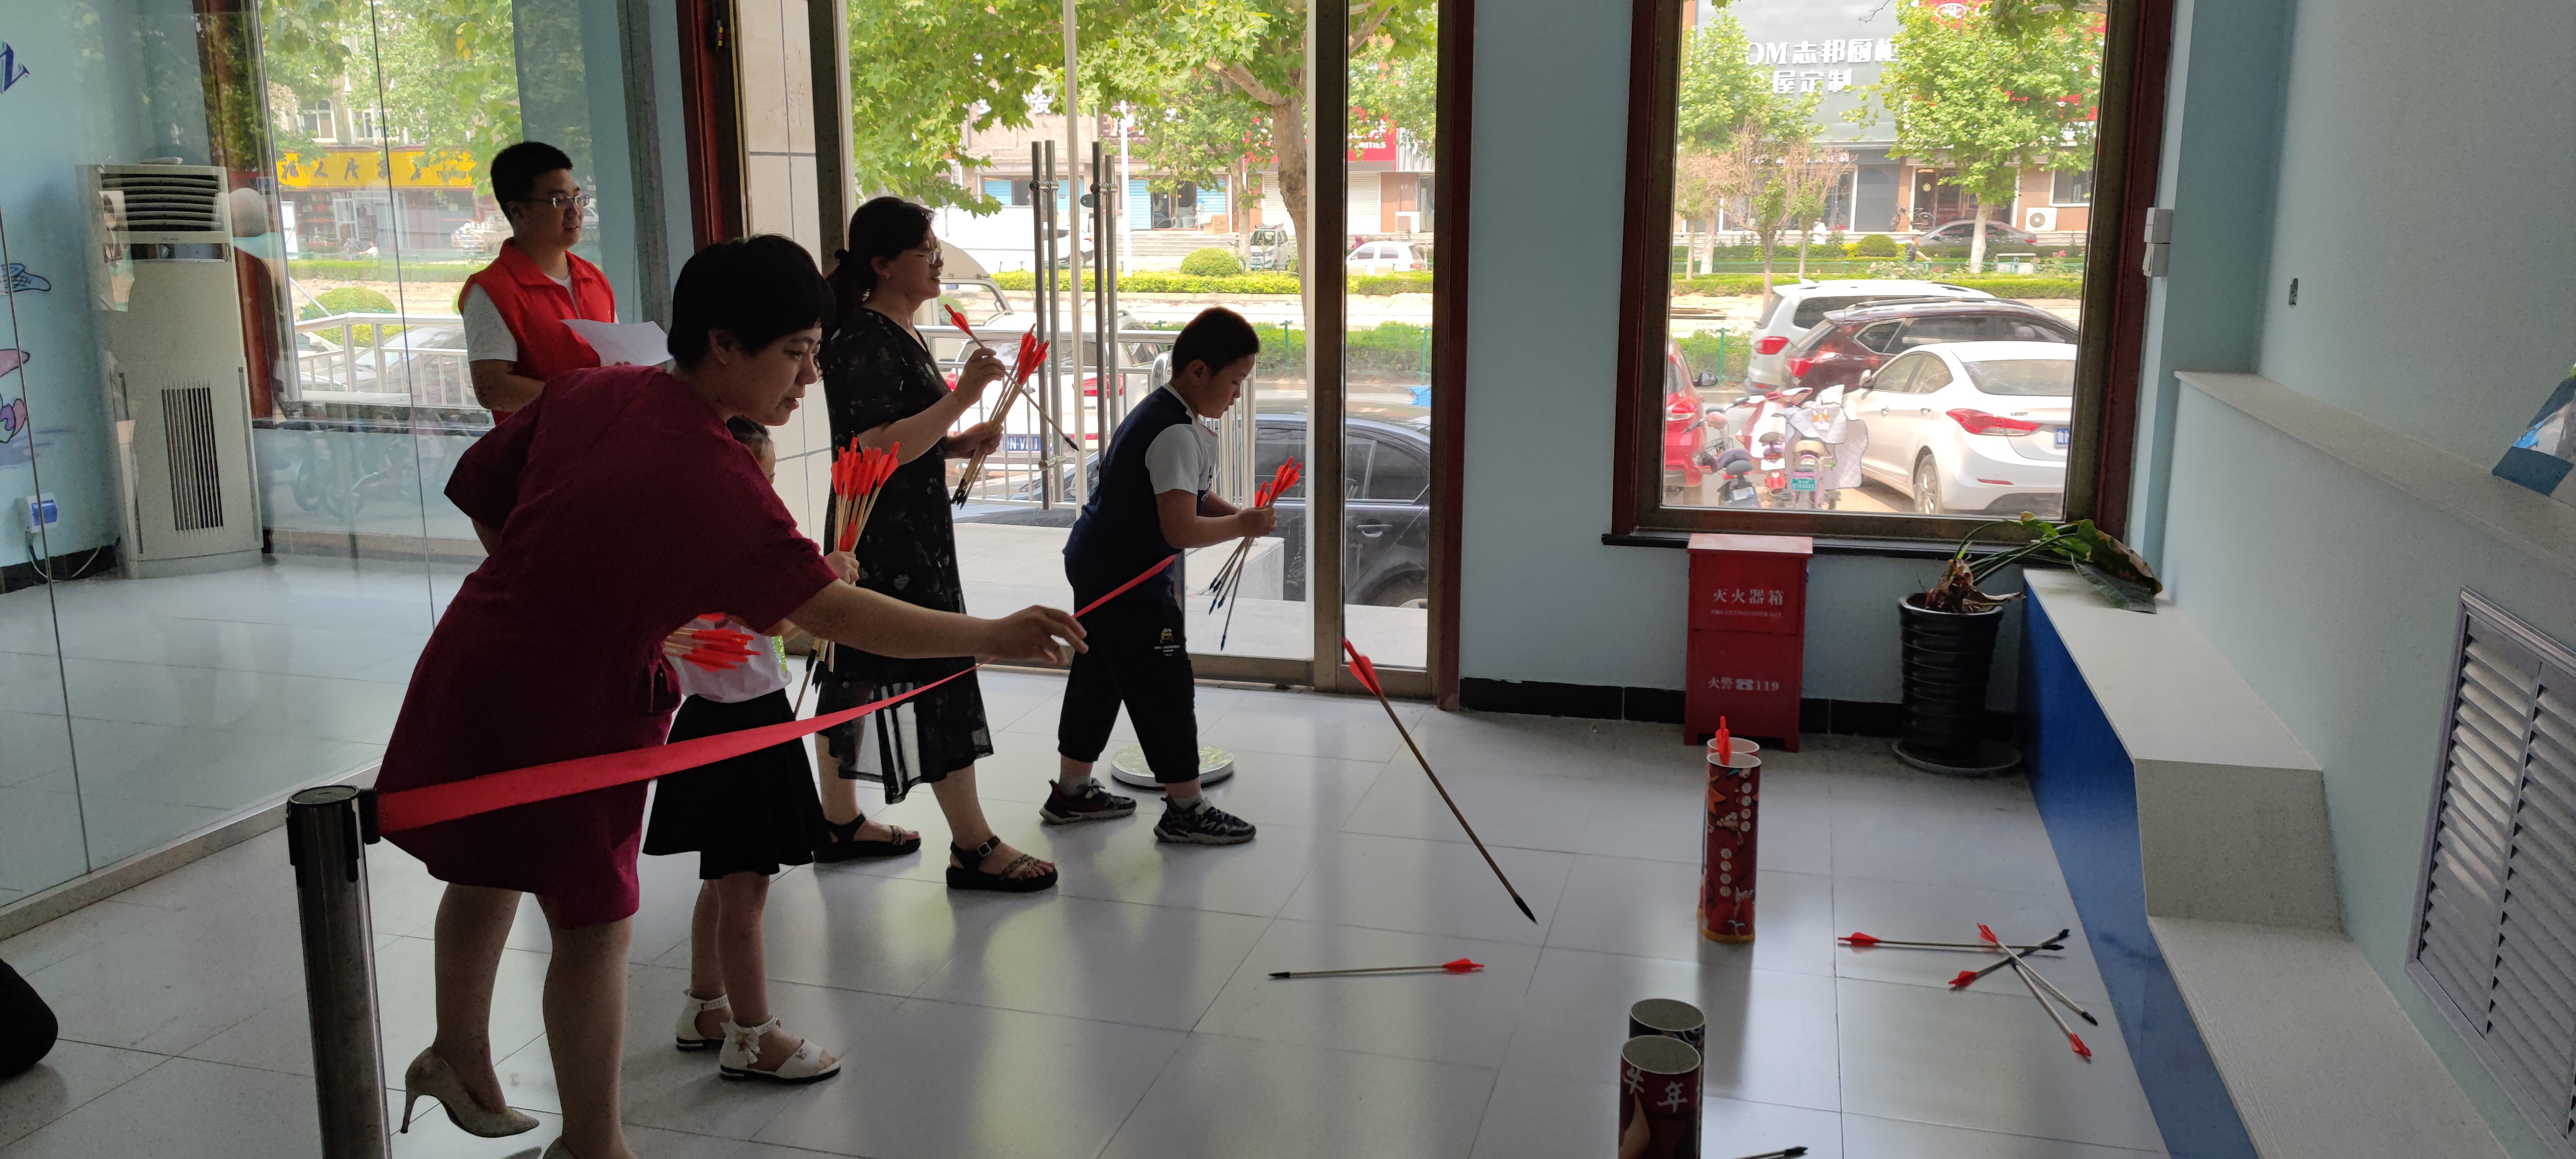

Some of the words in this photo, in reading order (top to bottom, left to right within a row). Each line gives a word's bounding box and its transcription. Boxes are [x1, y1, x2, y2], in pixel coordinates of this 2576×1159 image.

[1792, 38, 1899, 64] 志邦厨柜
[1753, 69, 1852, 94] 屋定制
[1713, 588, 1784, 605] 灭火器箱
[1757, 681, 1779, 691] 119
